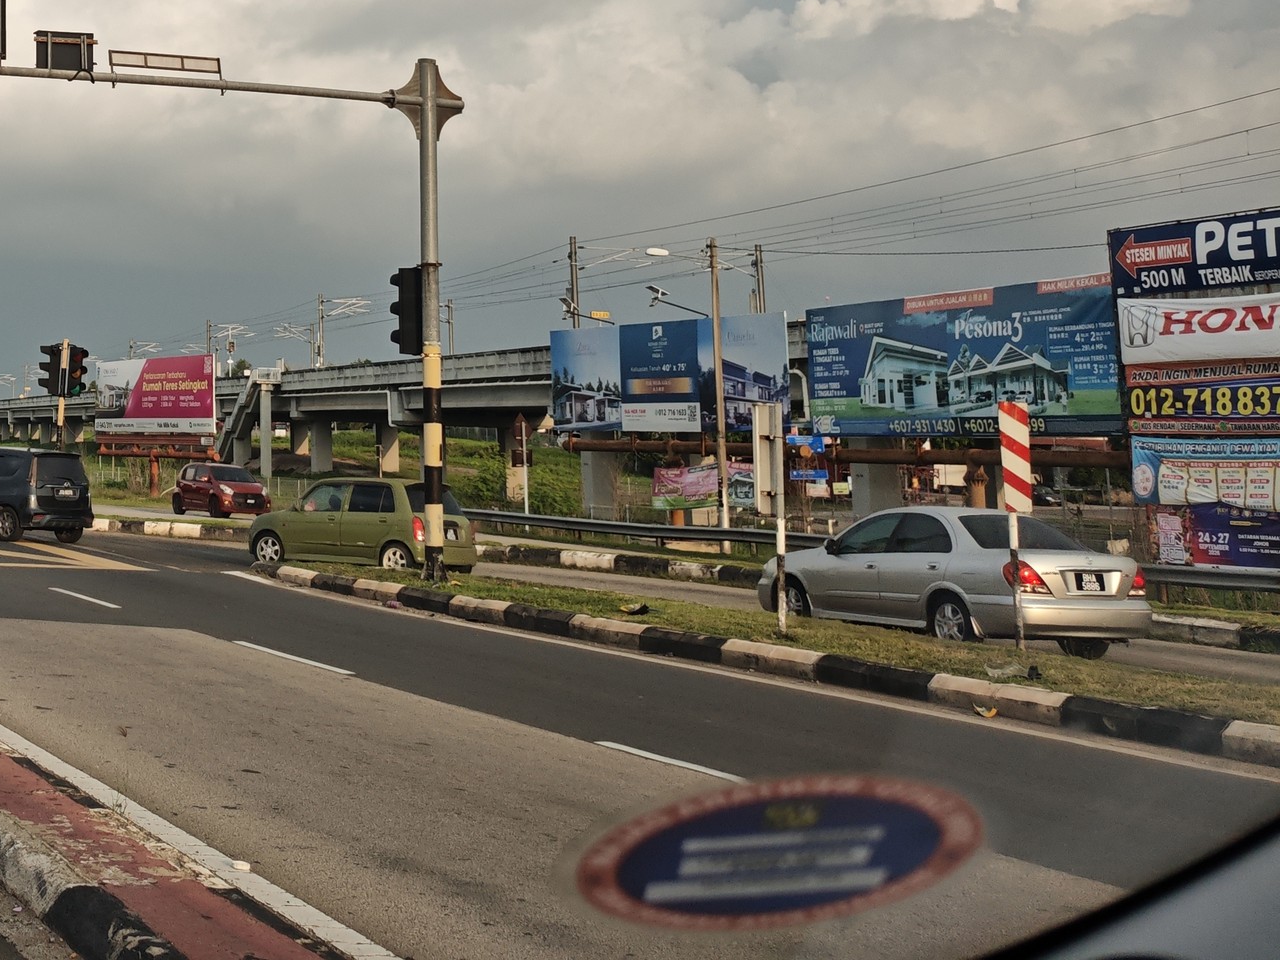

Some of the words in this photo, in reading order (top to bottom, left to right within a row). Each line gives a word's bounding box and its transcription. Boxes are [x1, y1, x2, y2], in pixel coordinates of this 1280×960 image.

[1195, 217, 1280, 264] PET
[1125, 247, 1156, 263] STESEN
[1157, 243, 1189, 260] MINYAK
[1141, 269, 1169, 289] 500
[1172, 268, 1186, 285] M
[1198, 265, 1253, 285] TERBAIK
[1042, 283, 1055, 291] HAK
[1057, 280, 1075, 290] MILIK
[1076, 277, 1098, 288] KEKAL
[810, 318, 857, 347] Rajawali
[1090, 332, 1096, 342] 2
[1131, 370, 1159, 382] ANDA
[1161, 368, 1191, 381] INGIN
[1193, 364, 1243, 380] MENJUAL
[142, 381, 162, 391] Rumah
[163, 381, 178, 390] Teres
[178, 379, 208, 393] Setingkat
[889, 420, 930, 432] +607-931
[932, 419, 955, 431] 1430
[1180, 422, 1216, 431] SEDERHANA
[1230, 423, 1261, 431] TAWARAN
[1185, 443, 1228, 454] PENGANUT
[1230, 443, 1256, 454] DEWA
[1198, 532, 1210, 543] 24
[1218, 533, 1230, 544] 27
[1198, 544, 1230, 552] SEPTEMBER
